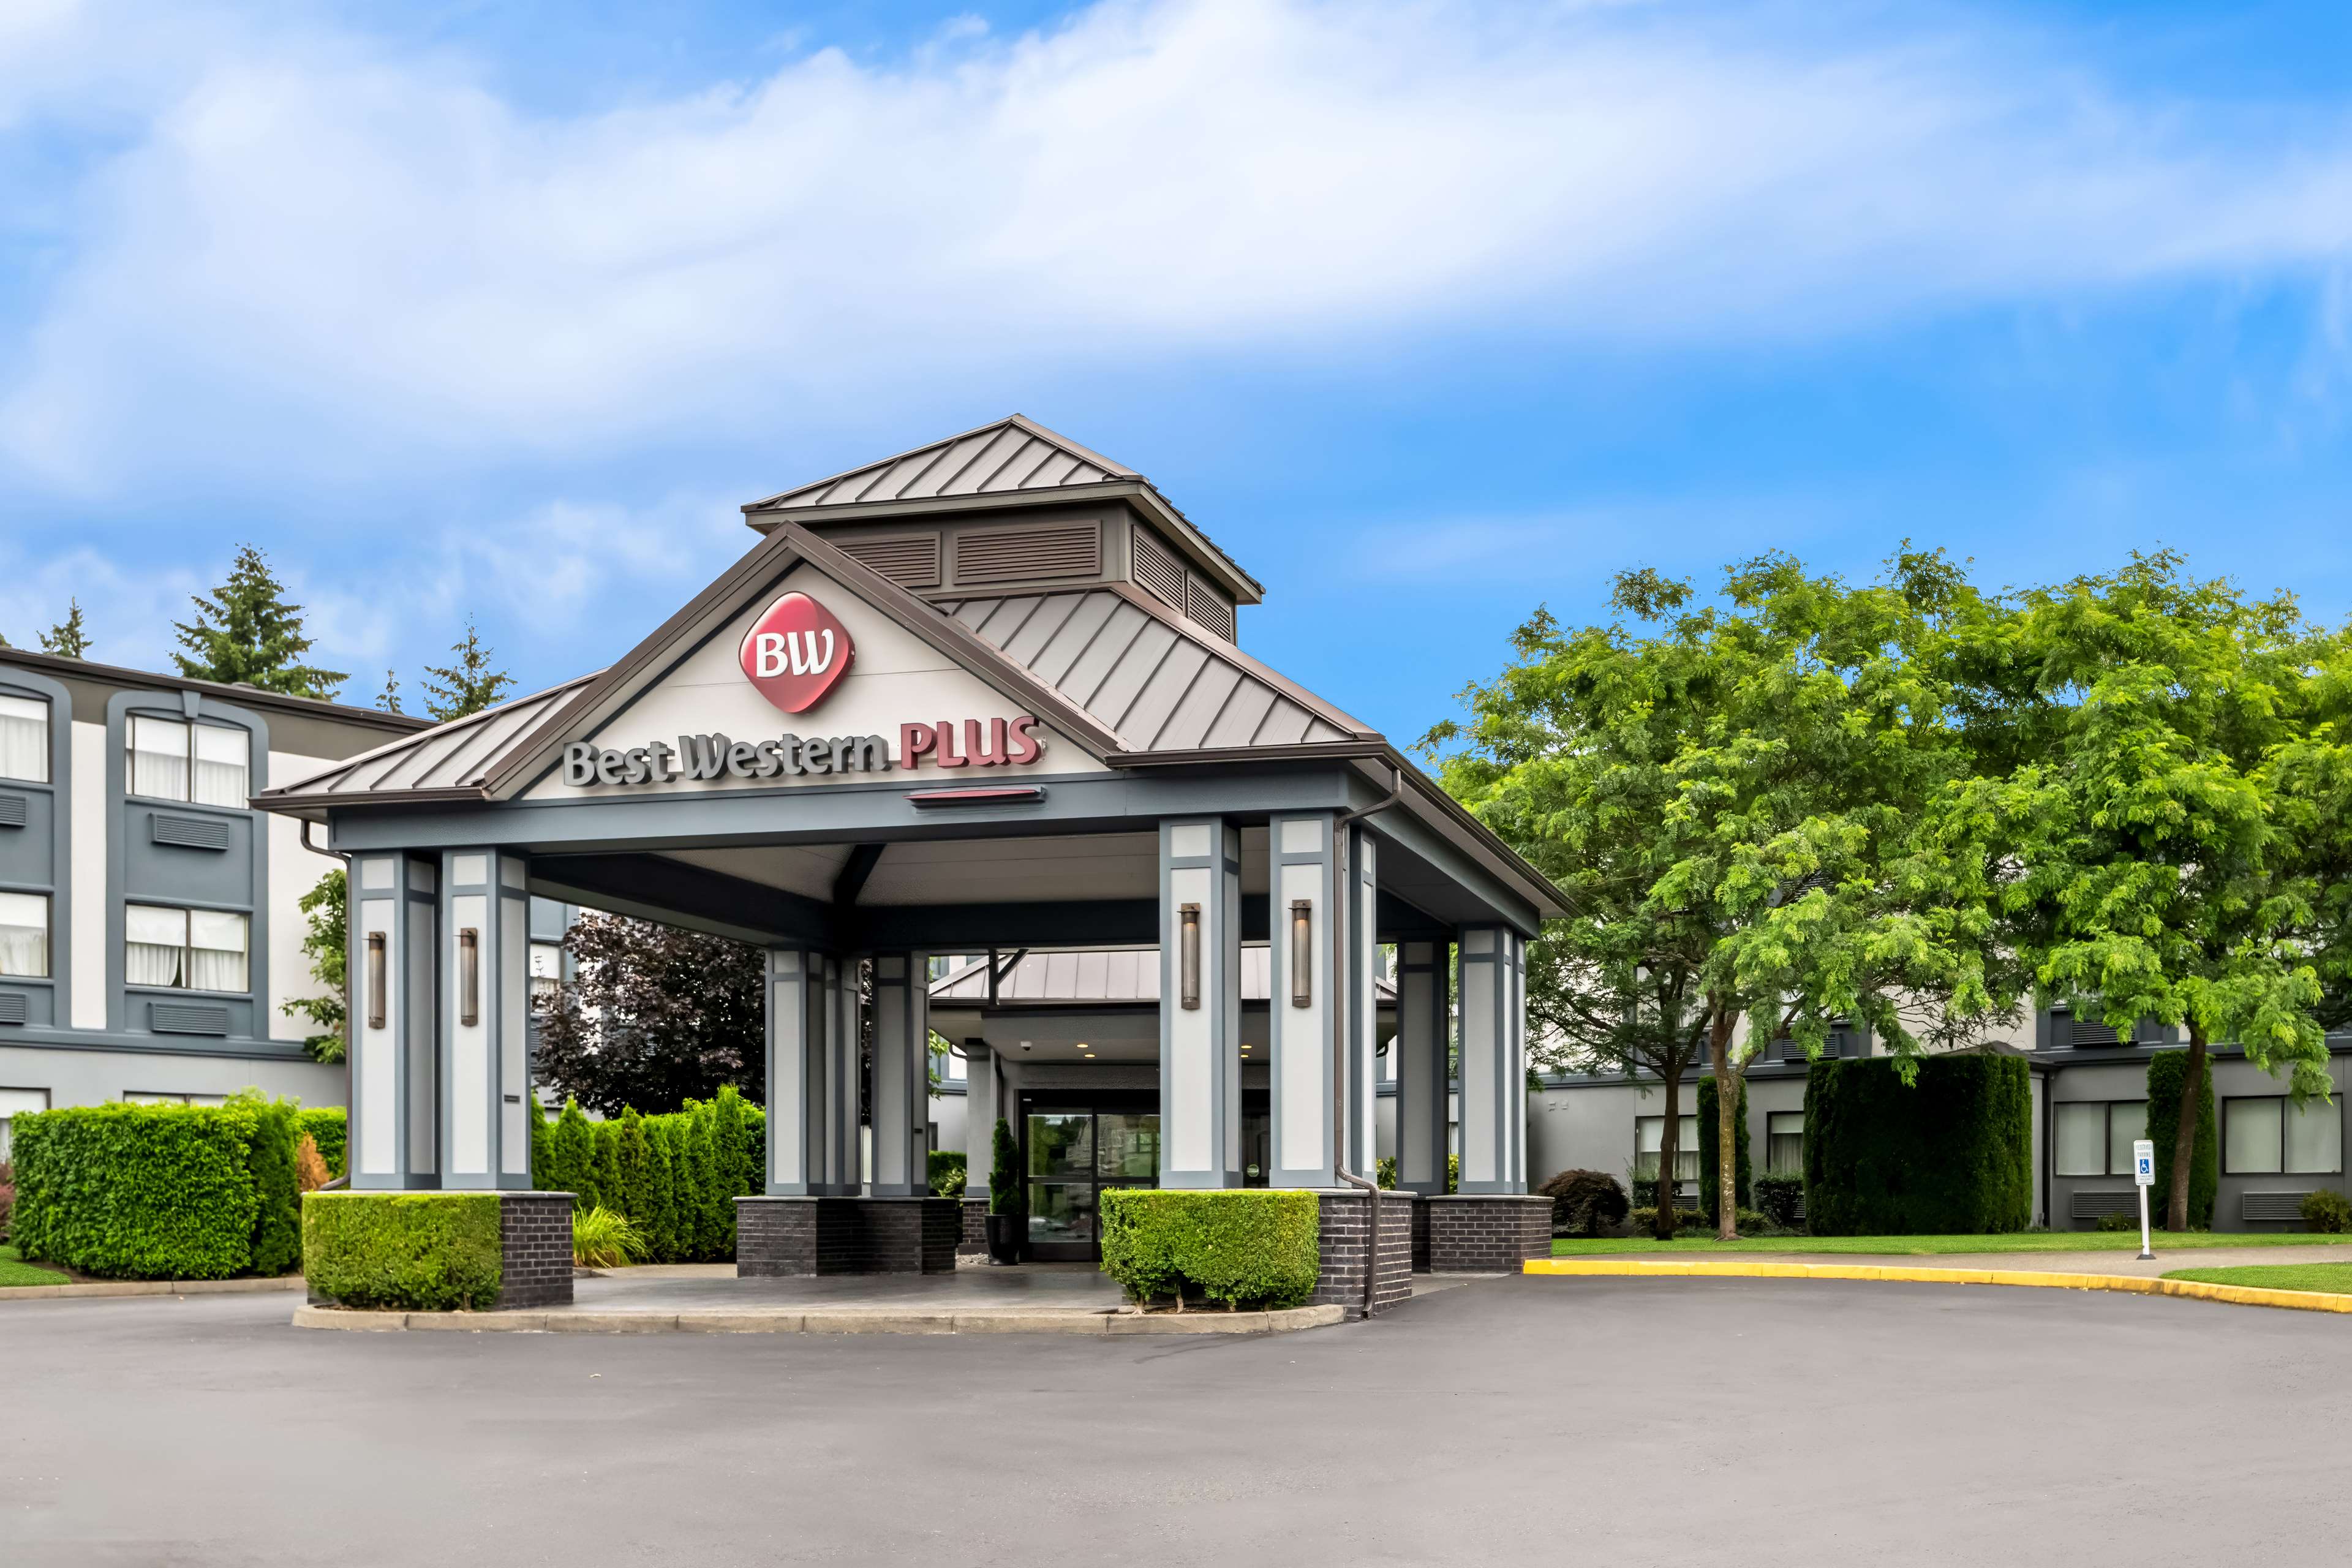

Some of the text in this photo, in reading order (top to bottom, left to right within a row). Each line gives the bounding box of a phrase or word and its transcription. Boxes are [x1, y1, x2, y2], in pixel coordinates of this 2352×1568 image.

[755, 628, 834, 678] BW
[564, 715, 1040, 787] Best Western PLUS
